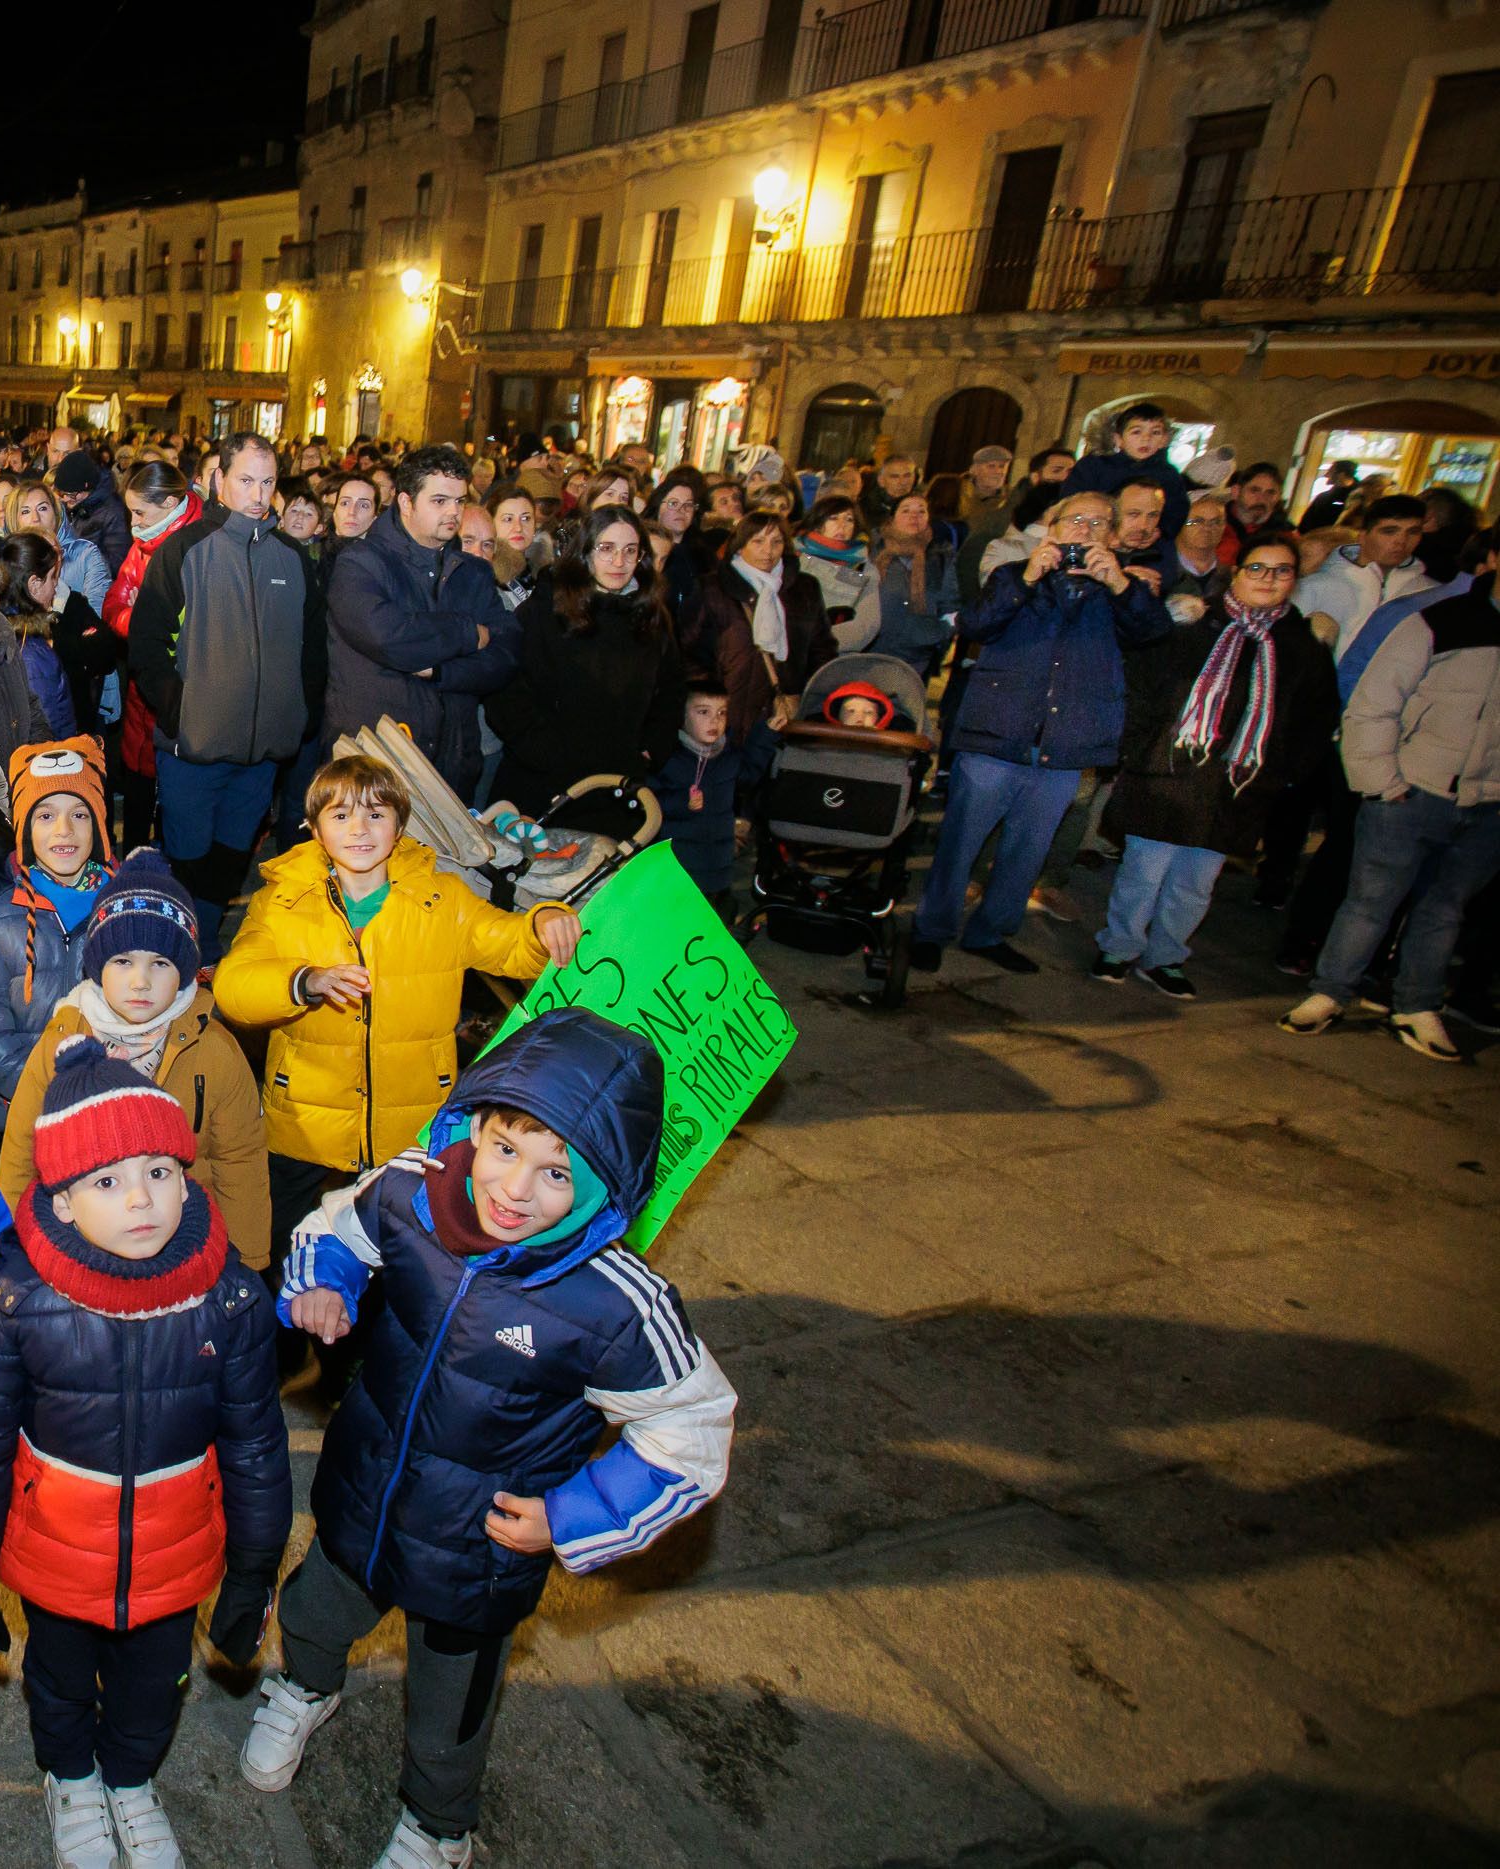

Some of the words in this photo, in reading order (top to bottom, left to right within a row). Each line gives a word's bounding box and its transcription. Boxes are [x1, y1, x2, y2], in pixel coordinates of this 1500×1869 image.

[1087, 353, 1202, 370] RELOJERIA
[679, 978, 790, 1123] RURALES
[495, 1330, 537, 1358] adidas
